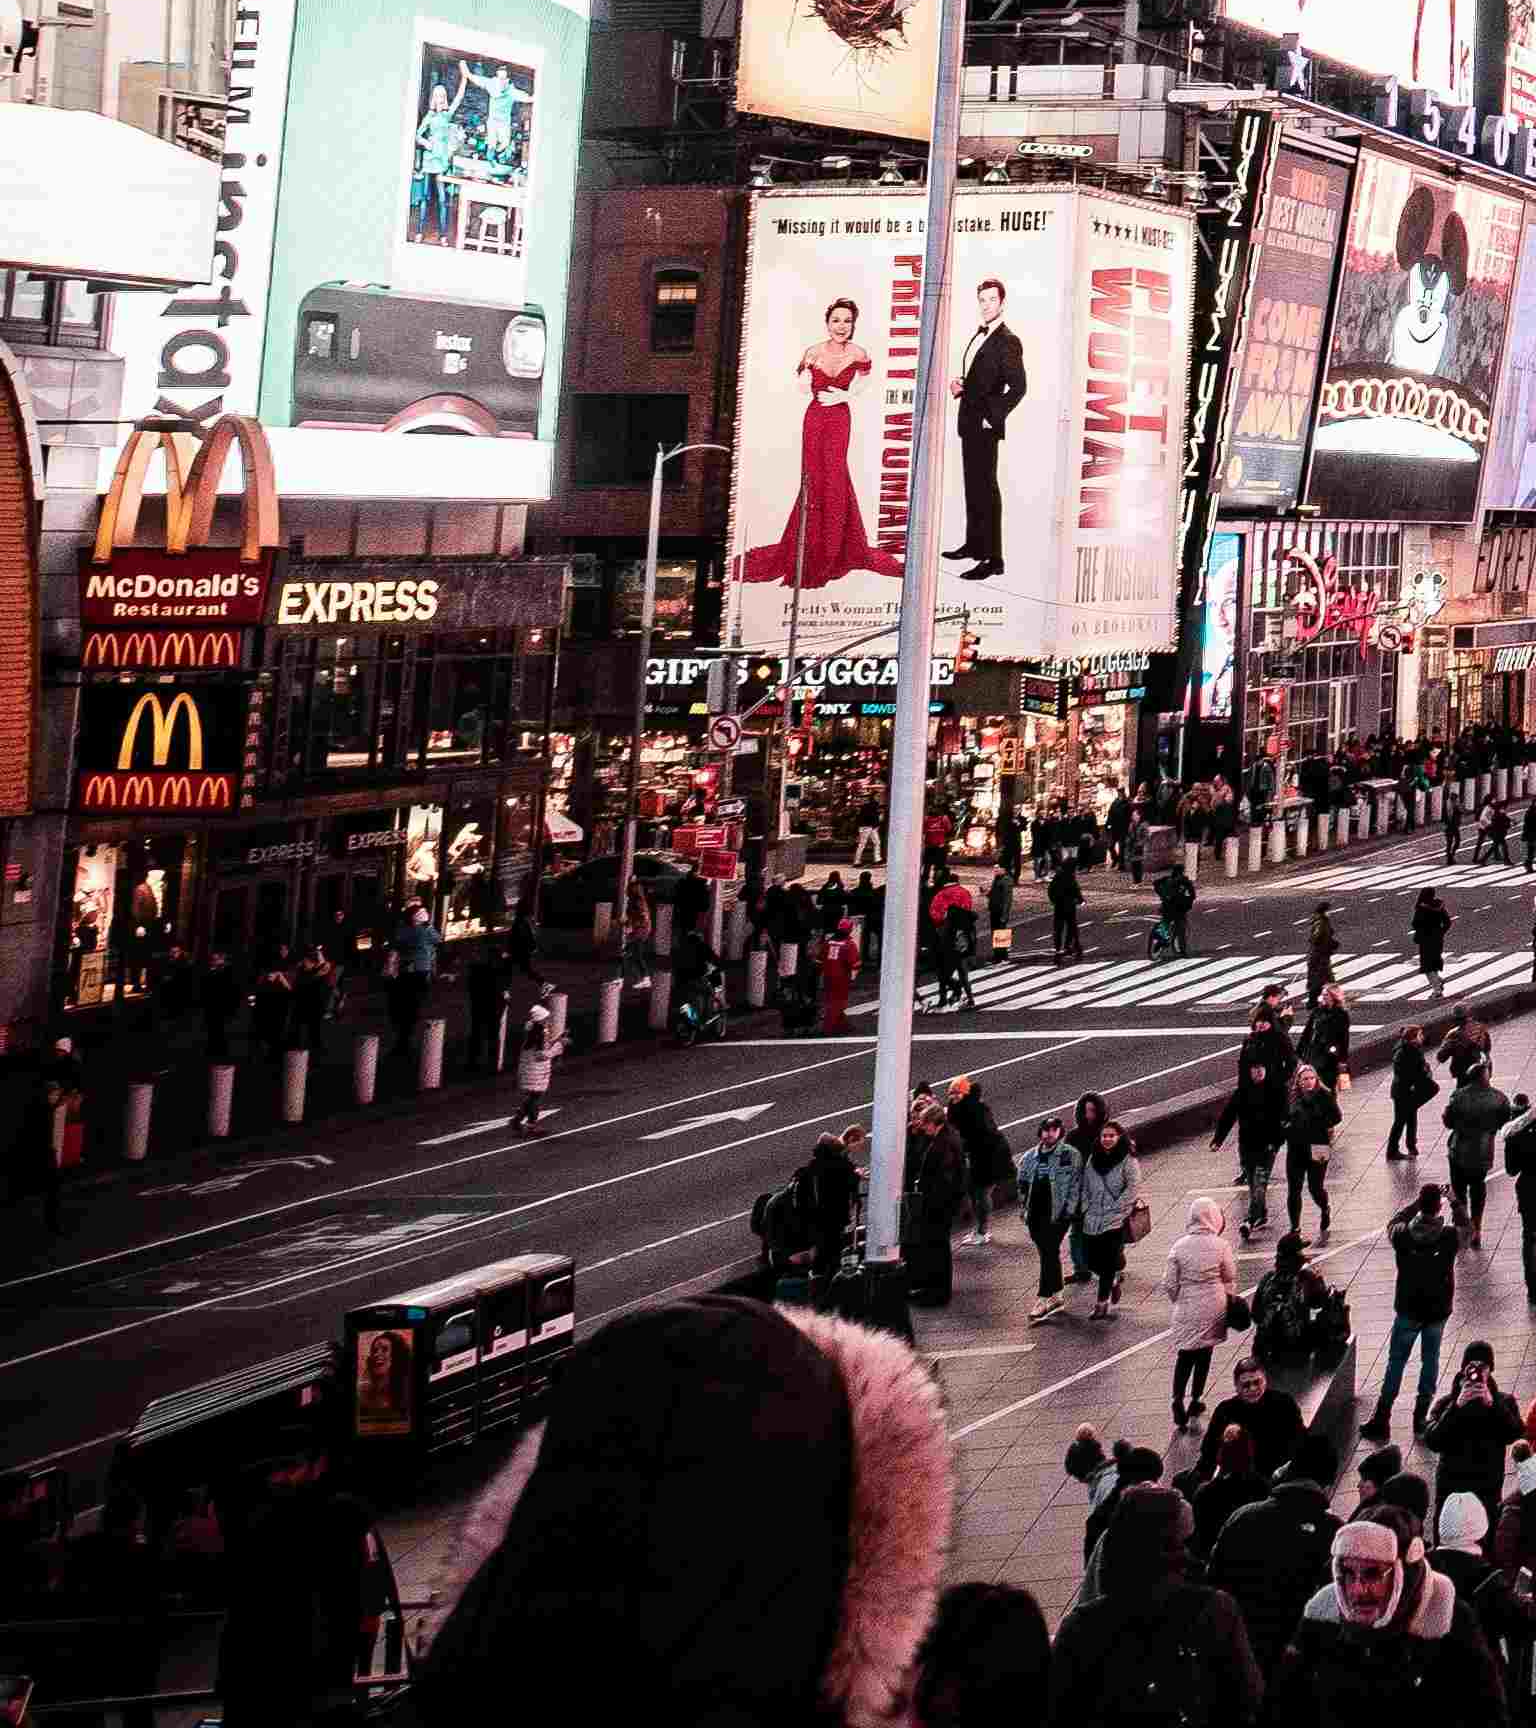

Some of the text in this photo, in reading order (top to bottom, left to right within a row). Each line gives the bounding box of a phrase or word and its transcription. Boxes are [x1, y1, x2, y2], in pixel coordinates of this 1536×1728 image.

[830, 217, 840, 233] it
[845, 217, 881, 234] would
[886, 217, 902, 233] be
[905, 220, 913, 233] a
[1079, 267, 1133, 529] WOMAN
[85, 573, 260, 599] McDonald's
[113, 602, 229, 618] Restaurant
[277, 580, 440, 625] EXPRESS
[644, 658, 955, 686] GIFS LUGGAE
[248, 839, 314, 864] EXPRESS
[347, 828, 409, 851] EXPRESS
